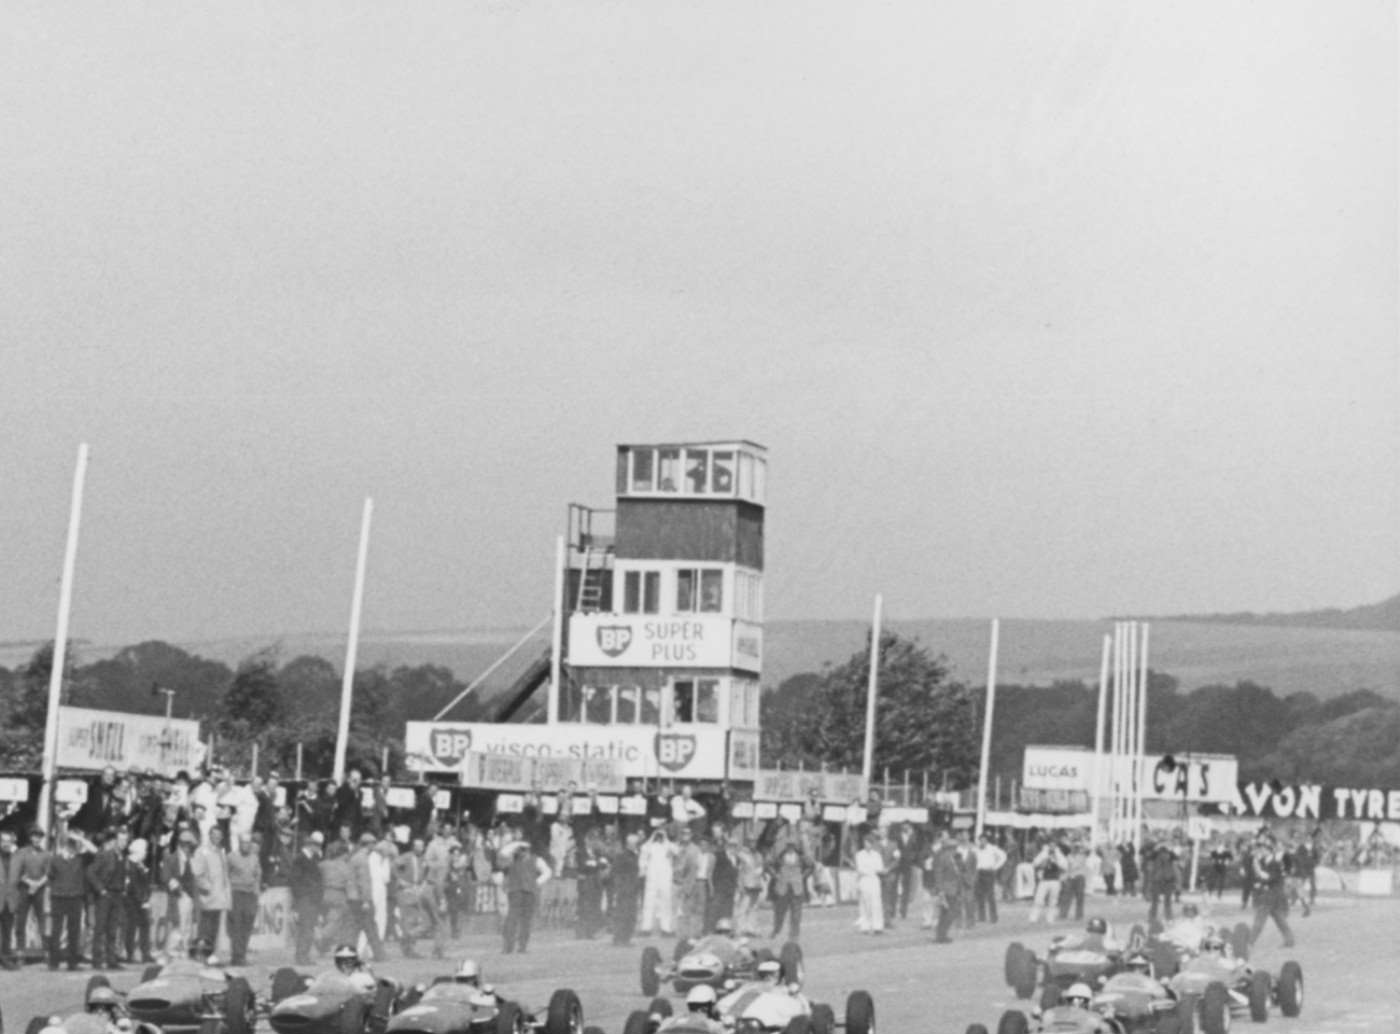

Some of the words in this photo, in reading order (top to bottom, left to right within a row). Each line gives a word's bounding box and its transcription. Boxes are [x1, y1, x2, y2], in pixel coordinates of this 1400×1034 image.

[600, 628, 631, 651] BP
[643, 622, 704, 640] SUPER
[651, 643, 697, 660] PLUS
[434, 732, 468, 758] BP
[658, 736, 695, 764] BP
[1028, 763, 1078, 778] LUCAS
